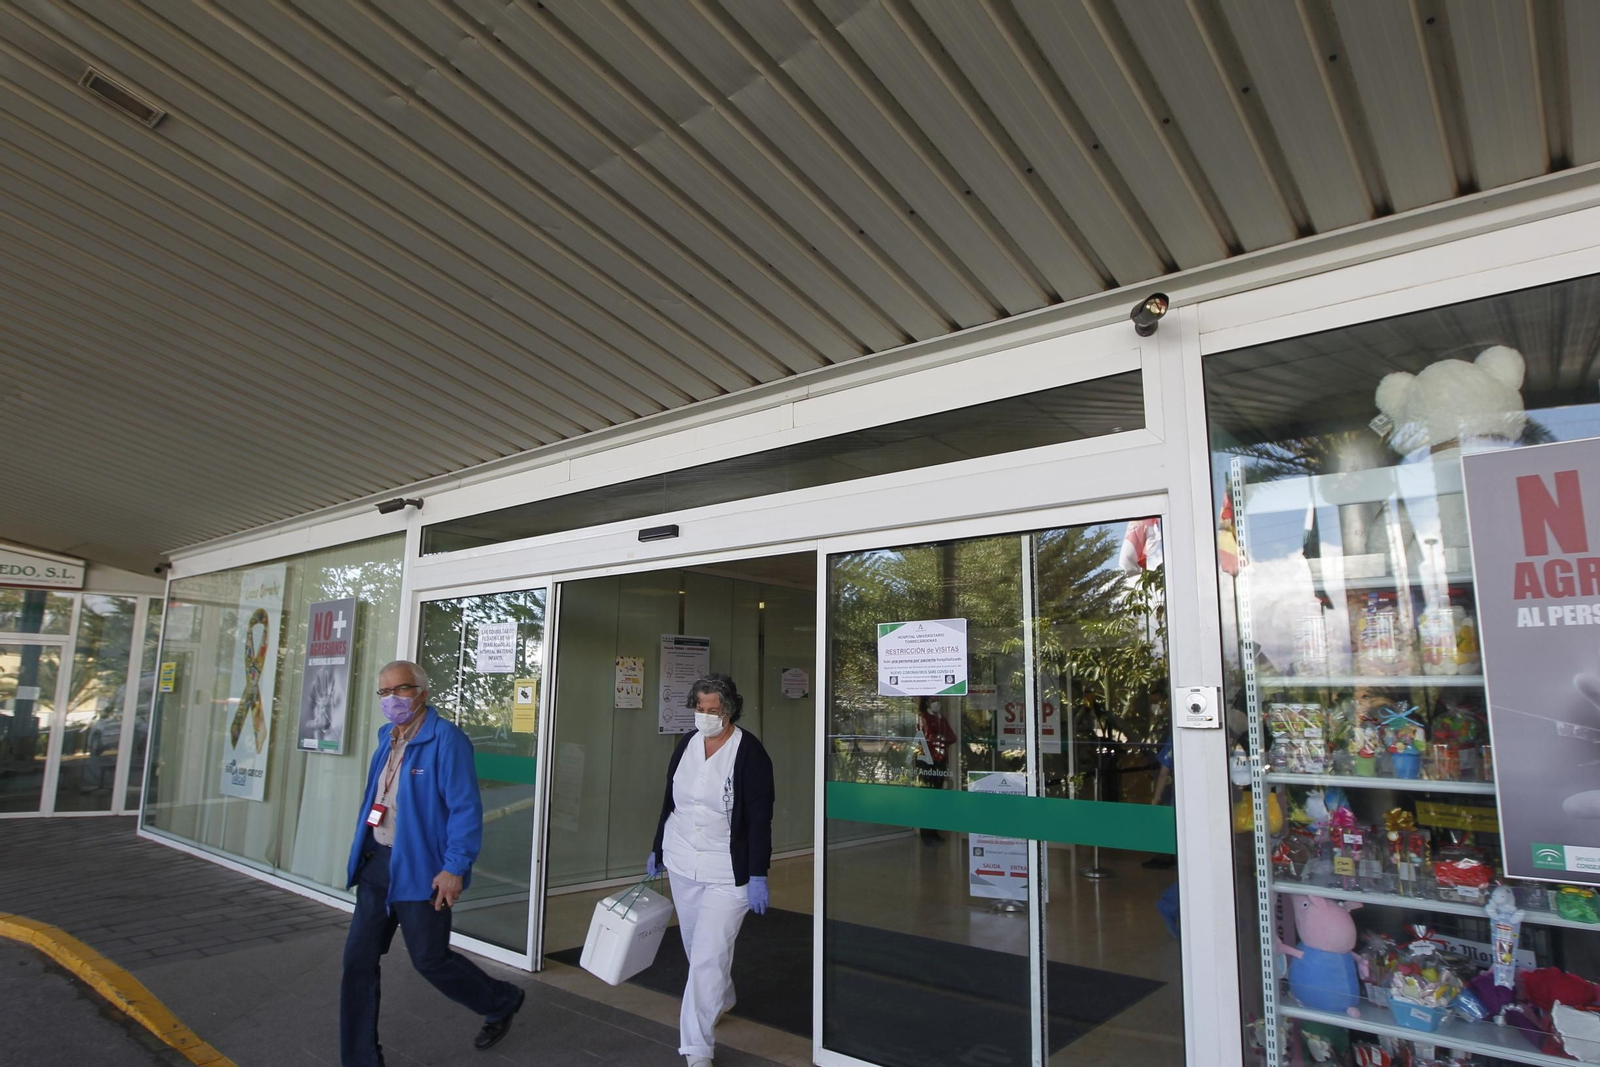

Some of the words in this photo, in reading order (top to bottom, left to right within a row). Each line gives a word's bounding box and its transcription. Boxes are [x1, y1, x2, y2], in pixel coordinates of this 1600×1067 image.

[45, 567, 76, 579] S.L.
[1514, 557, 1600, 600] AGR
[1517, 607, 1545, 627] AL
[886, 647, 926, 655] RESTRICCIÓN
[1004, 701, 1054, 724] STP
